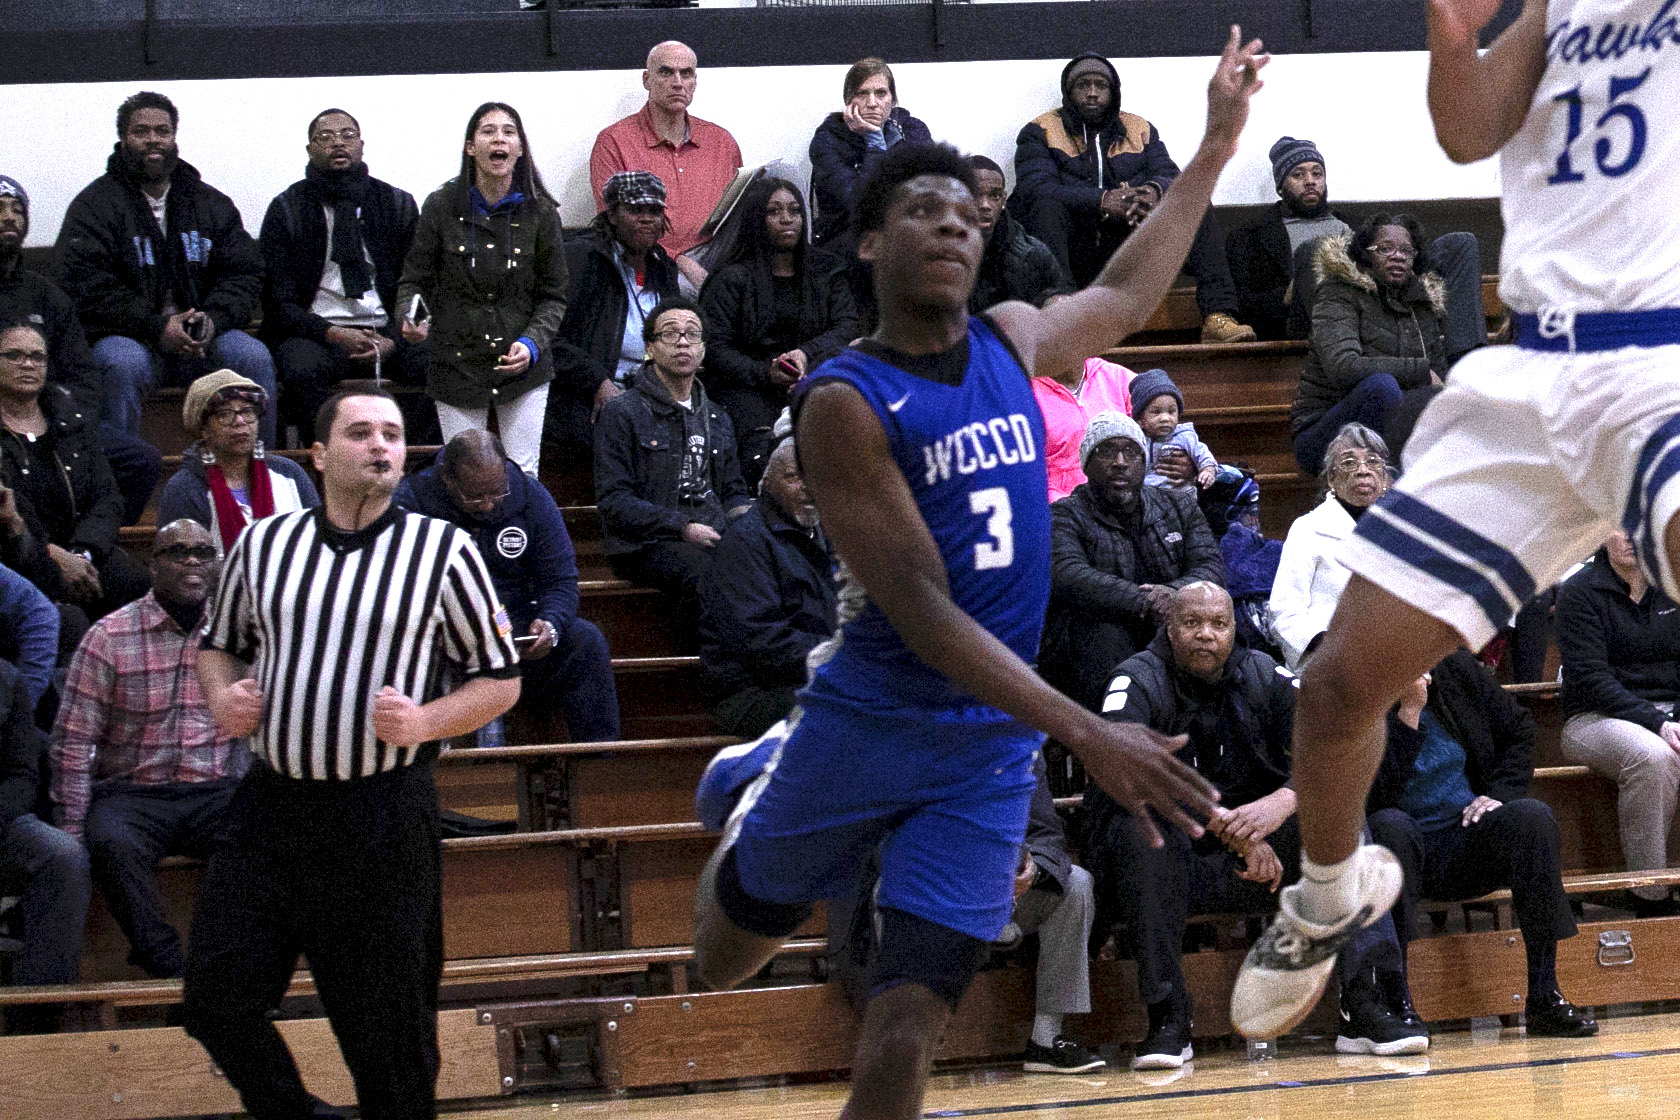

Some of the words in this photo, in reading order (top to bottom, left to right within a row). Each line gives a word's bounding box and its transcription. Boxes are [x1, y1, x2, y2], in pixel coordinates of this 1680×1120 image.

[1547, 66, 1653, 186] 15
[923, 413, 1036, 486] WCCCD
[968, 486, 1013, 571] 3
